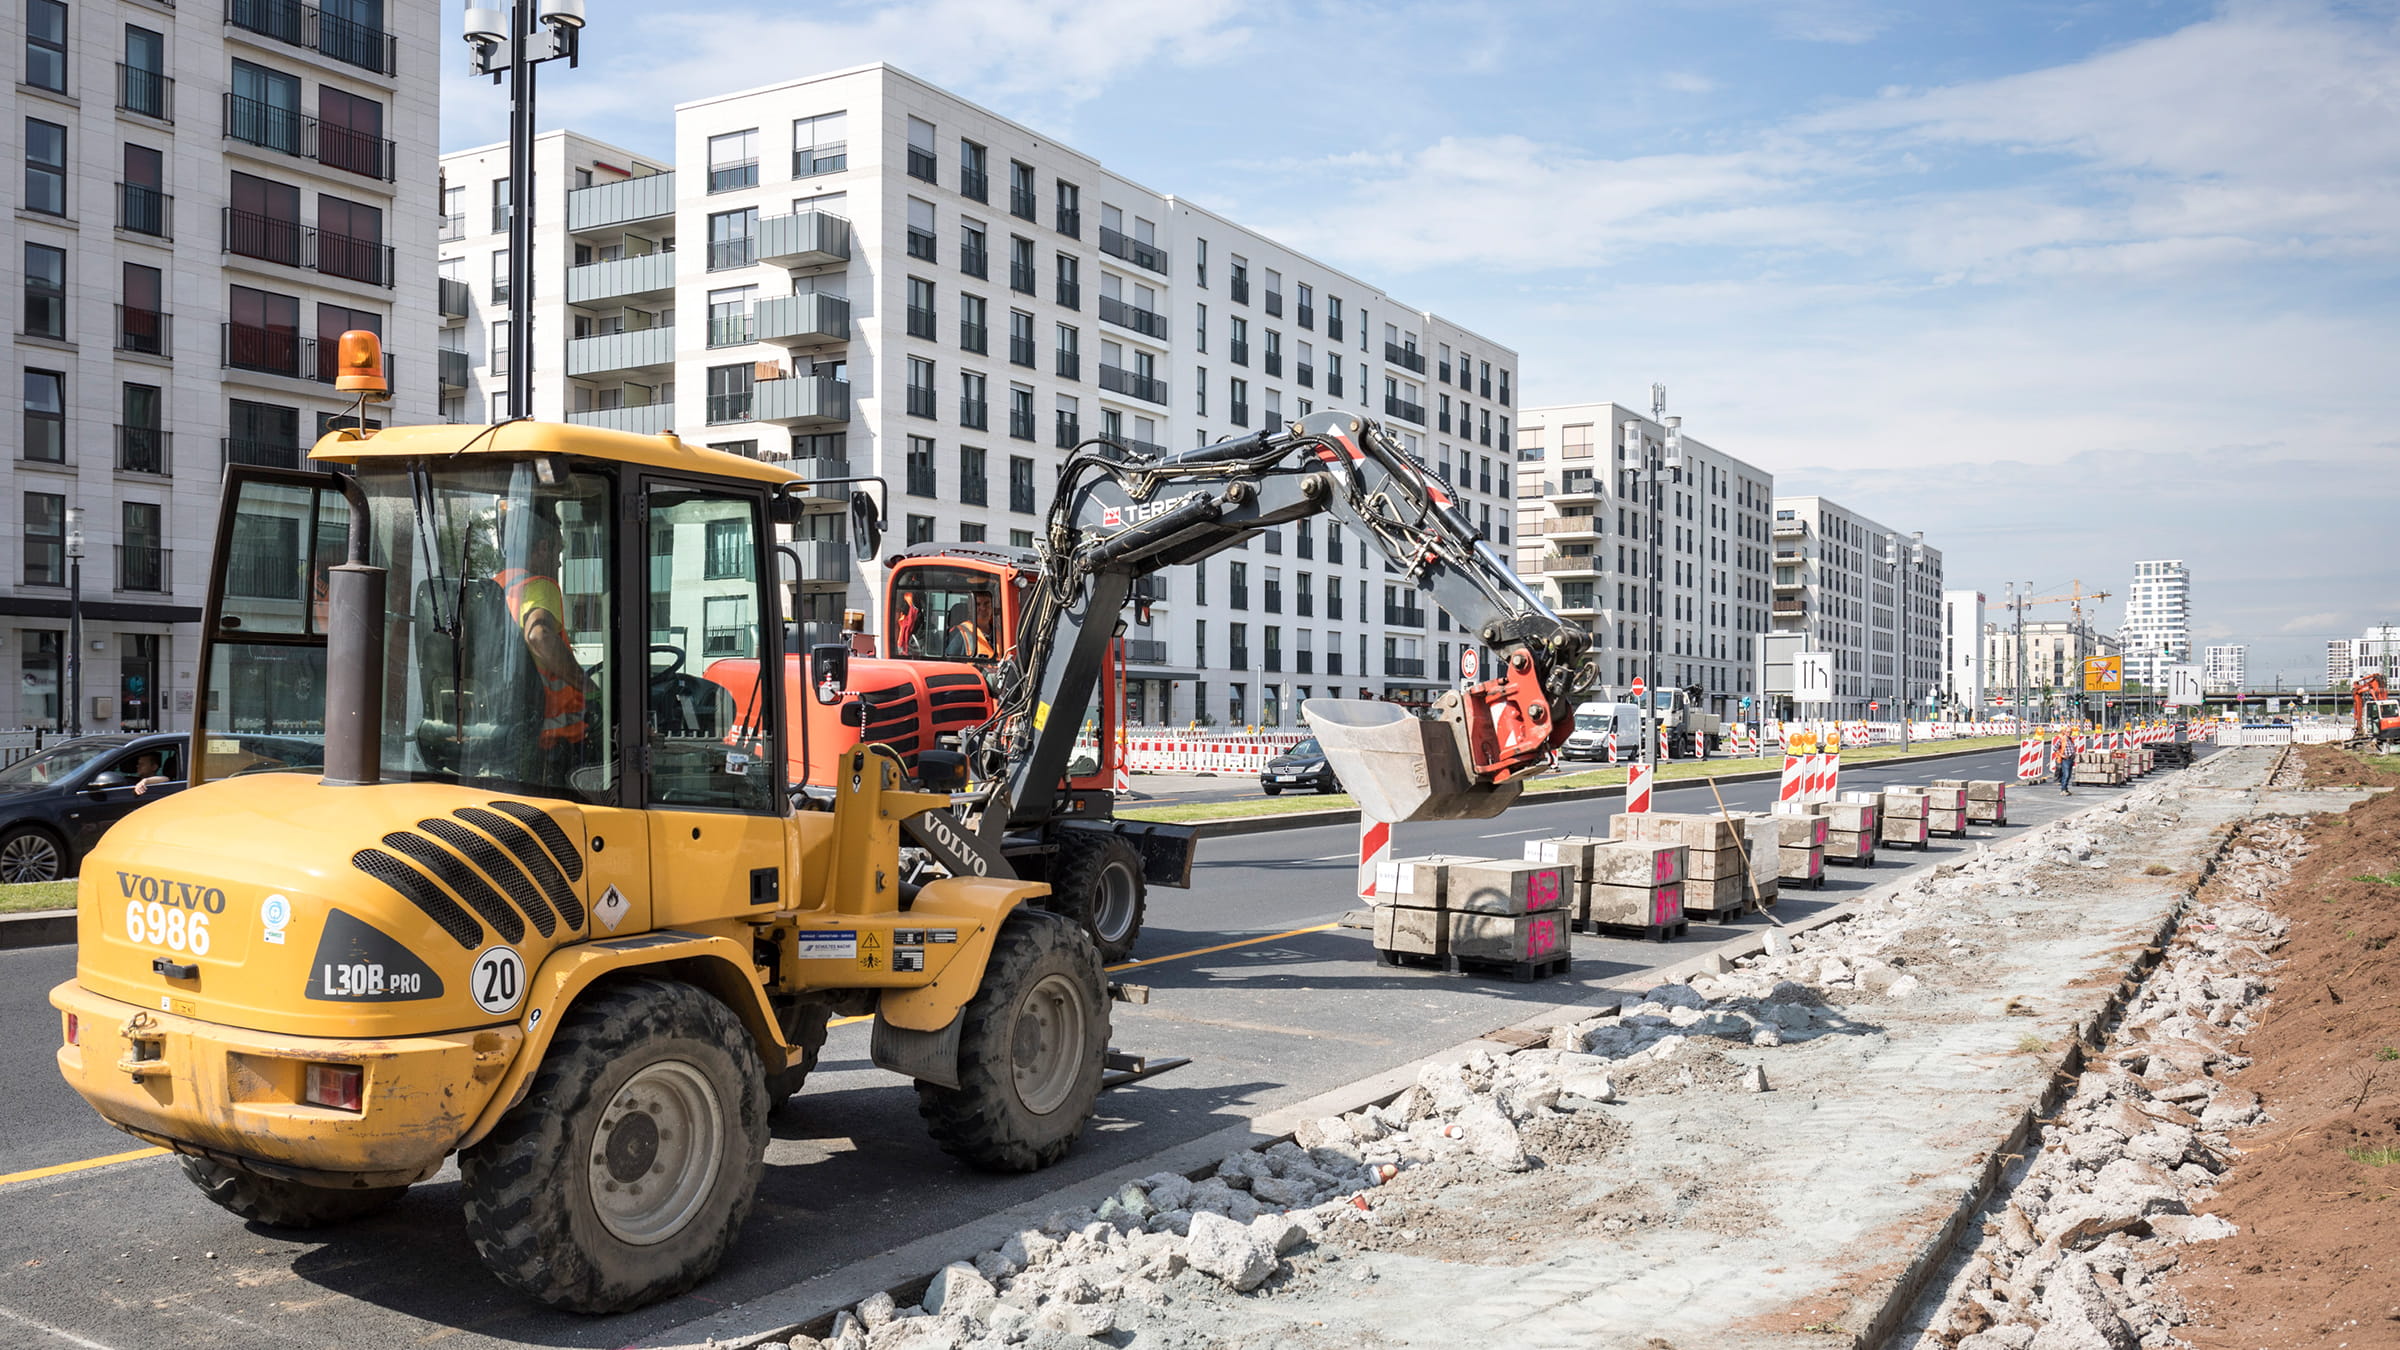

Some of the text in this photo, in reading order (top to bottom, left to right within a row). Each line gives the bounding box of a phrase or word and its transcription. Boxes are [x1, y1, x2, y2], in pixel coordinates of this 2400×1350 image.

[924, 810, 988, 877] VOLVO
[116, 871, 226, 914] VOLVO
[126, 900, 210, 956] 6986
[324, 963, 421, 997] L30B PRO
[482, 958, 516, 1004] 20
